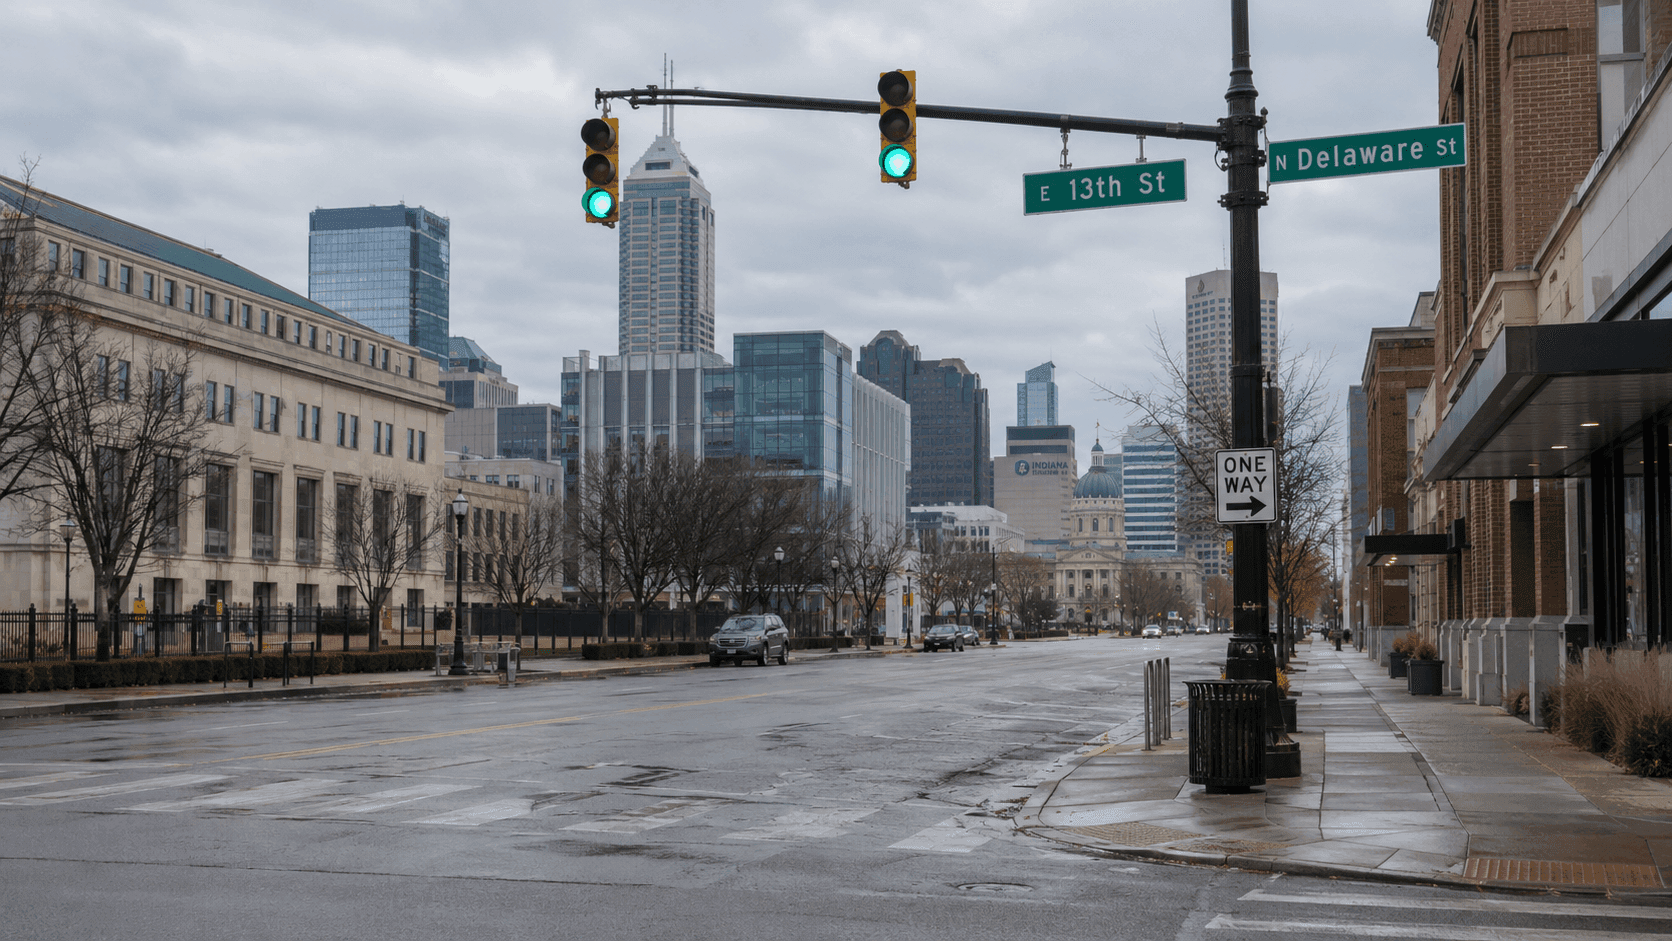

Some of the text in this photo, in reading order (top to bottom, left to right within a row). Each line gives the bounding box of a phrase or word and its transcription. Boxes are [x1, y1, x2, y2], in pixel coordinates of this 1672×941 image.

[1275, 138, 1458, 171] N Delaware St
[1041, 171, 1166, 202] E 13th St
[1032, 461, 1069, 469] INDIANA
[1224, 456, 1266, 473] ONE
[1224, 476, 1267, 493] WAY
